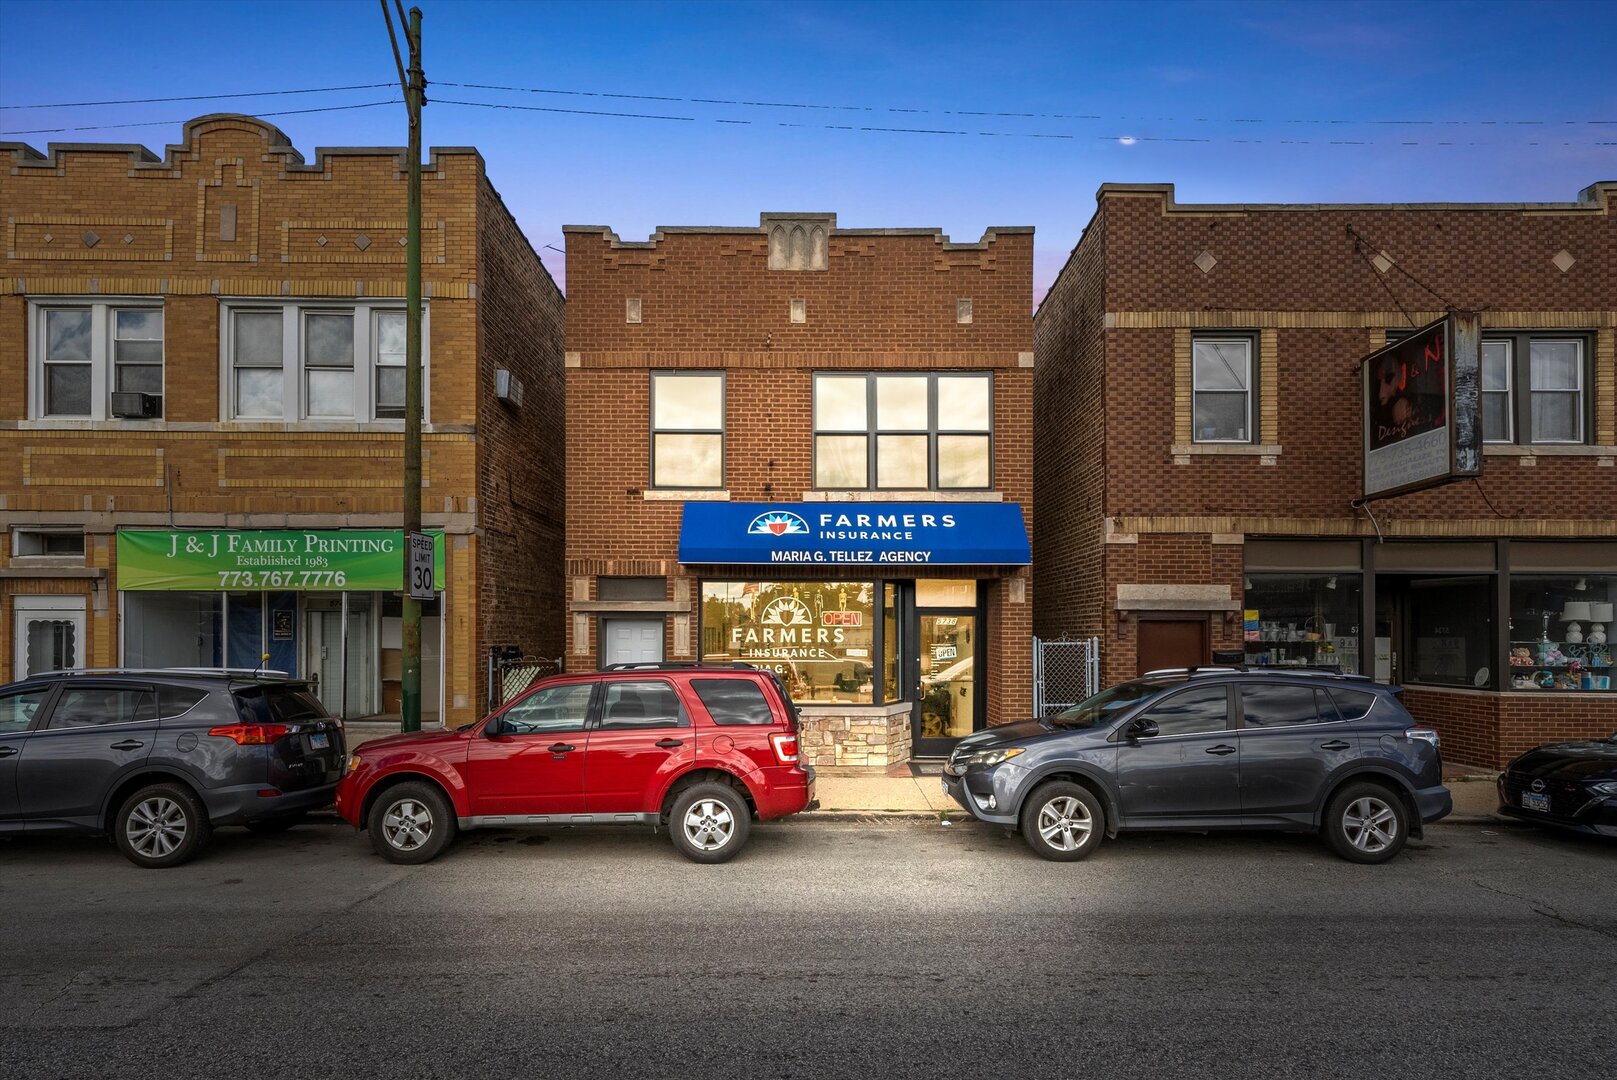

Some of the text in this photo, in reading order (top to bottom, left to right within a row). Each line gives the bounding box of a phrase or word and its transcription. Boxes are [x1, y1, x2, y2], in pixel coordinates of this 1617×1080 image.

[1397, 333, 1442, 391] J & N
[820, 514, 956, 527] FARMERS
[820, 531, 913, 540] INSURANCE
[167, 534, 393, 557] J & J FAMILY PRINTING
[412, 538, 433, 551] SPEED
[236, 555, 329, 567] Established 1983
[414, 551, 430, 564] LIMIT
[771, 551, 931, 562] MARIA G. TELLEZ AGENCY
[218, 570, 346, 587] 773.767.7776
[413, 566, 432, 590] 30
[823, 613, 861, 625] OPEN
[732, 628, 845, 643] FARMERS
[749, 648, 825, 658] INSURANCE
[938, 648, 956, 658] OPEN
[775, 664, 788, 674] G.
